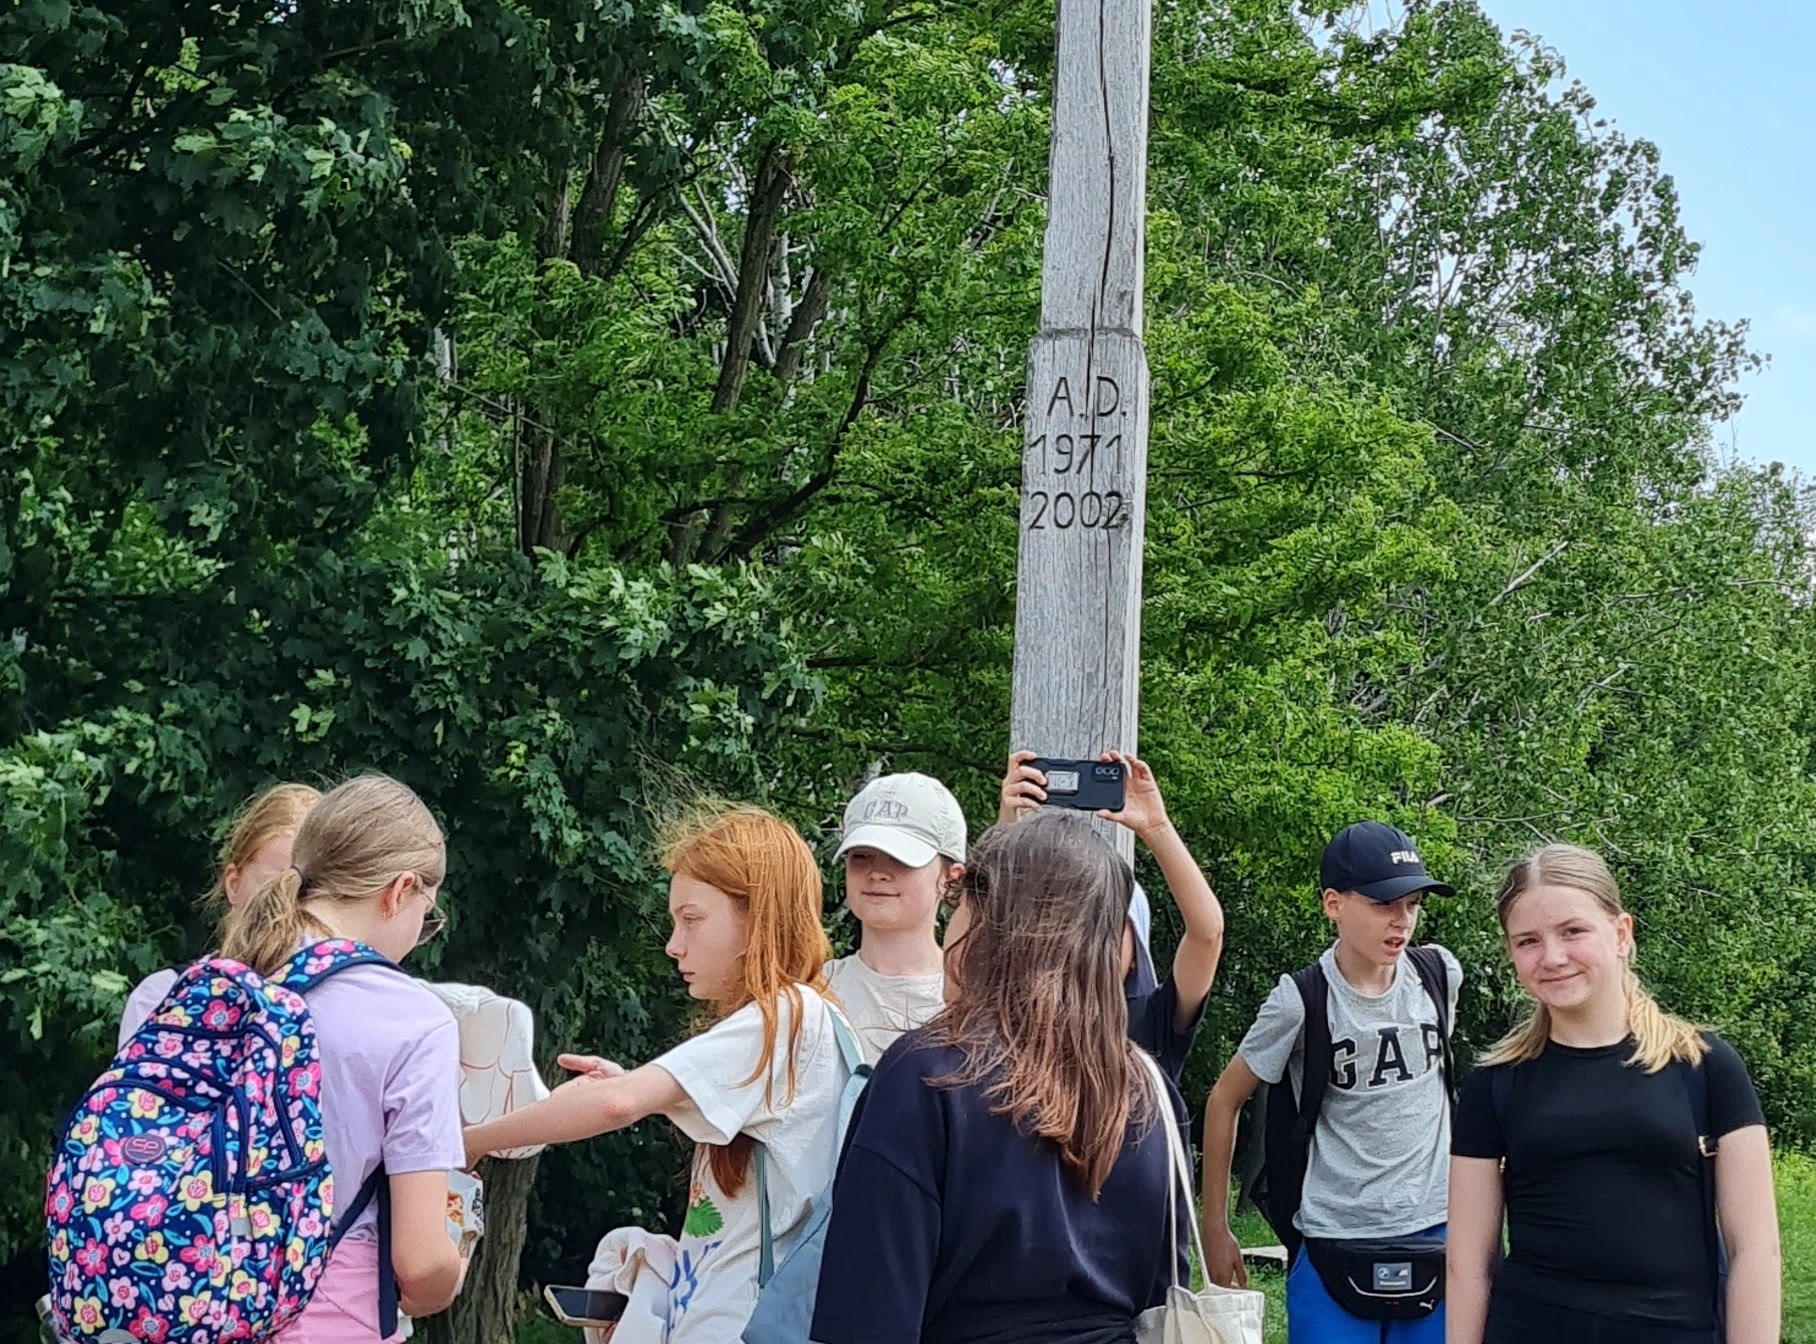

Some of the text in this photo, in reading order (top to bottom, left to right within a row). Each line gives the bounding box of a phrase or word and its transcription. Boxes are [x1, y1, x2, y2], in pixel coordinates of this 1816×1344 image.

[1047, 376, 1127, 418] A.D.
[1029, 433, 1122, 475] 1971
[1028, 490, 1124, 530] 2002
[863, 799, 909, 821] GAP
[1390, 850, 1420, 864] FILA
